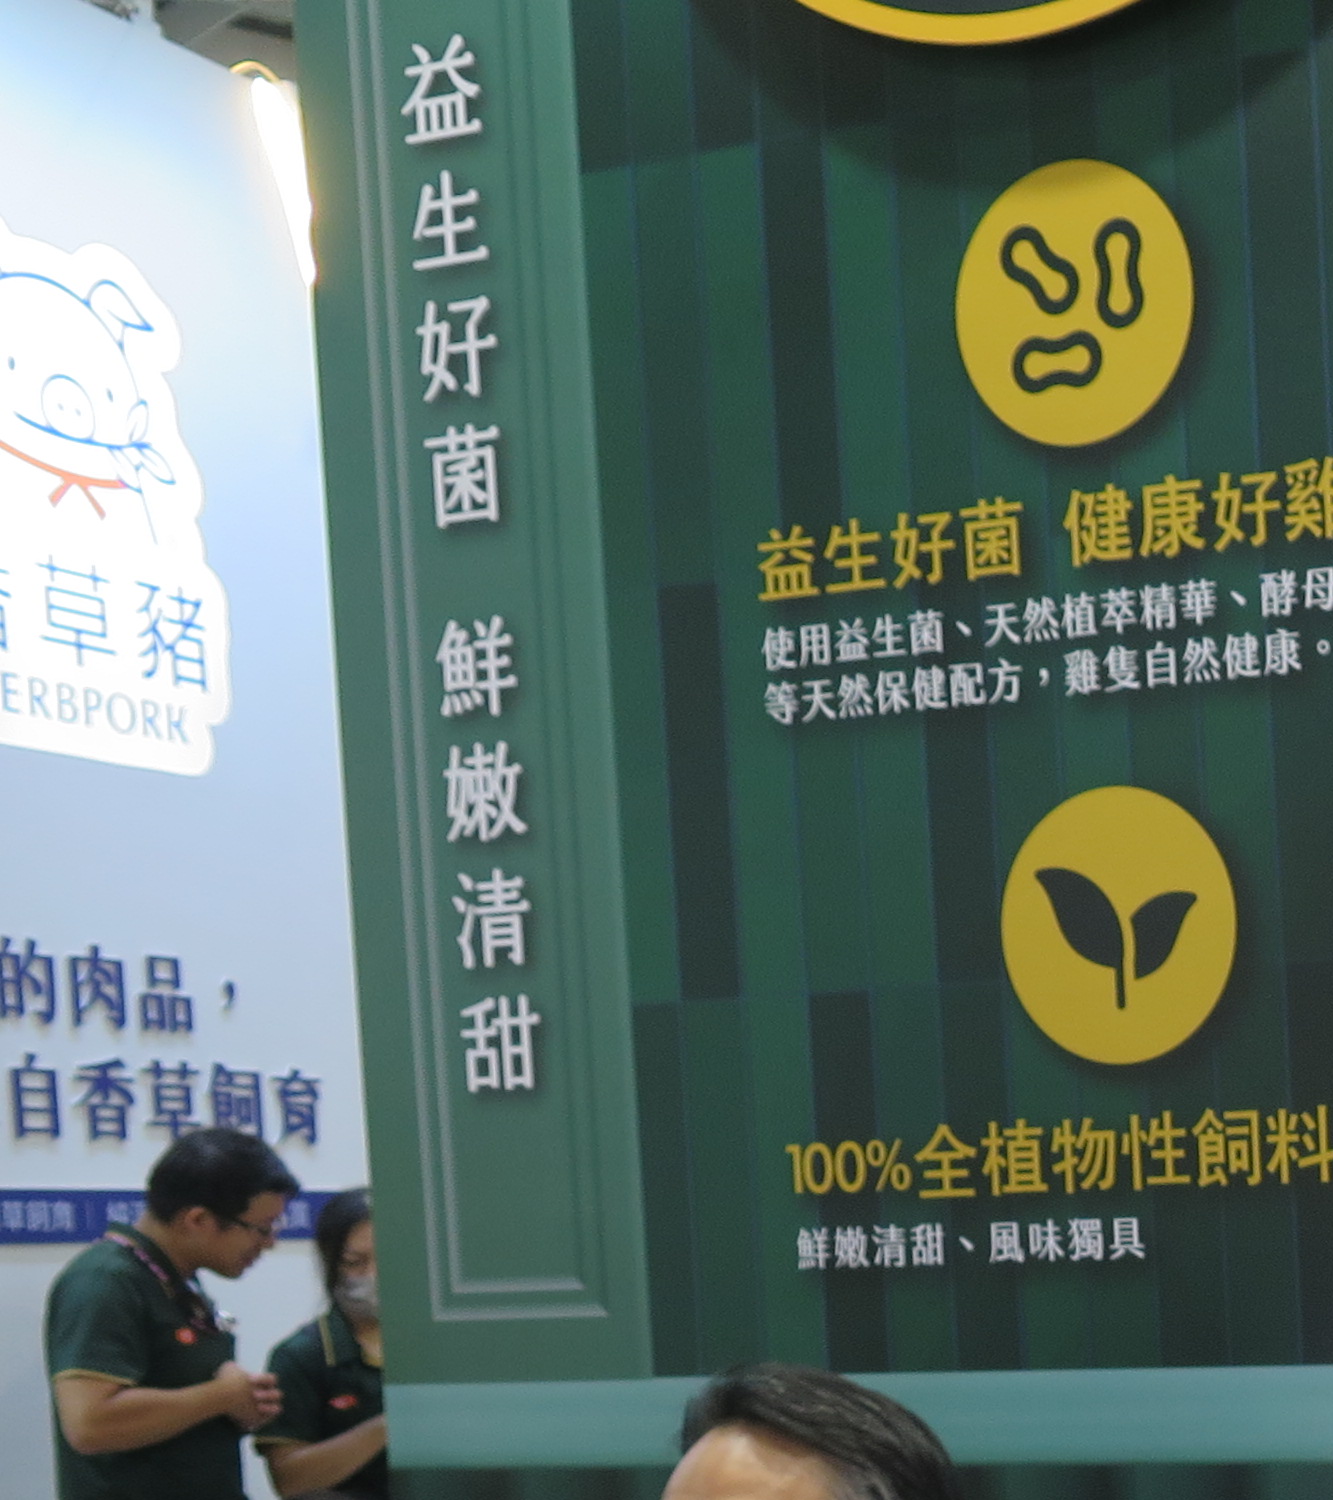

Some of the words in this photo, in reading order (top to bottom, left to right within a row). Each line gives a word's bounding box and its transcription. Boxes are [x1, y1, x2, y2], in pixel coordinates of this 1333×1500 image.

[401, 34, 500, 529] 益生好菌
[756, 500, 1024, 602] 益生好菌
[0, 555, 208, 693] 草豬
[762, 634, 1331, 726] 等天然保健配方，雞隻自然健康。
[436, 615, 541, 1092] 鮮嫩清甜
[10, 1054, 322, 1146] 自香草飼育
[796, 1216, 1147, 1270] 鮮嫩清甜、風味獨具
